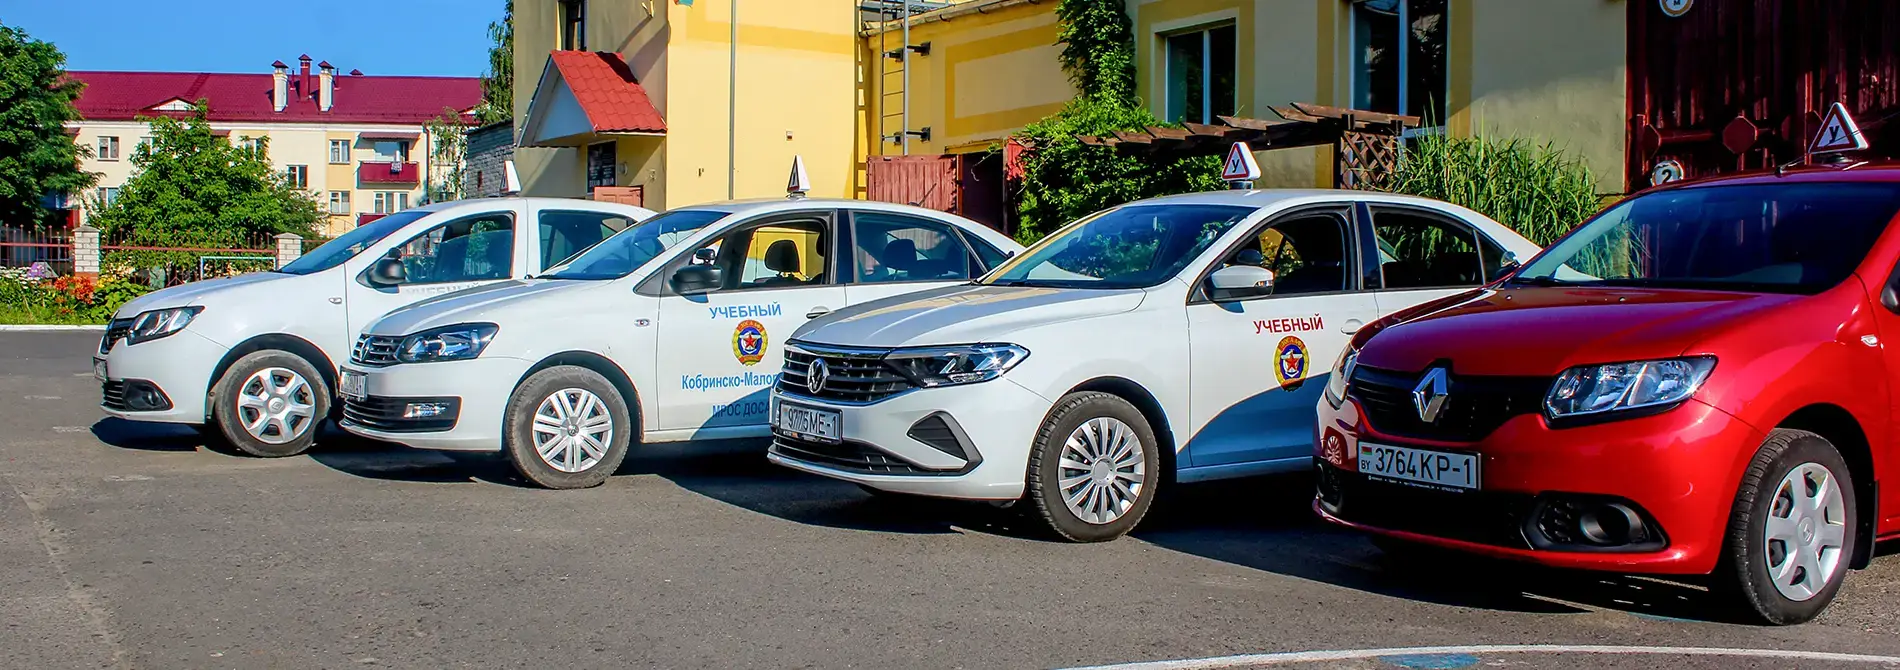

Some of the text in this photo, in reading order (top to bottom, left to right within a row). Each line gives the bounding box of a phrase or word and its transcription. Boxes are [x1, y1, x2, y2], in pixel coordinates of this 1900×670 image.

[1661, 168, 1672, 184] 2
[709, 301, 782, 319] УЧЕБНЫЙ
[1253, 313, 1324, 334] УЧЕБНЫЙ
[712, 402, 740, 418] МРОС
[1361, 459, 1371, 470] BY
